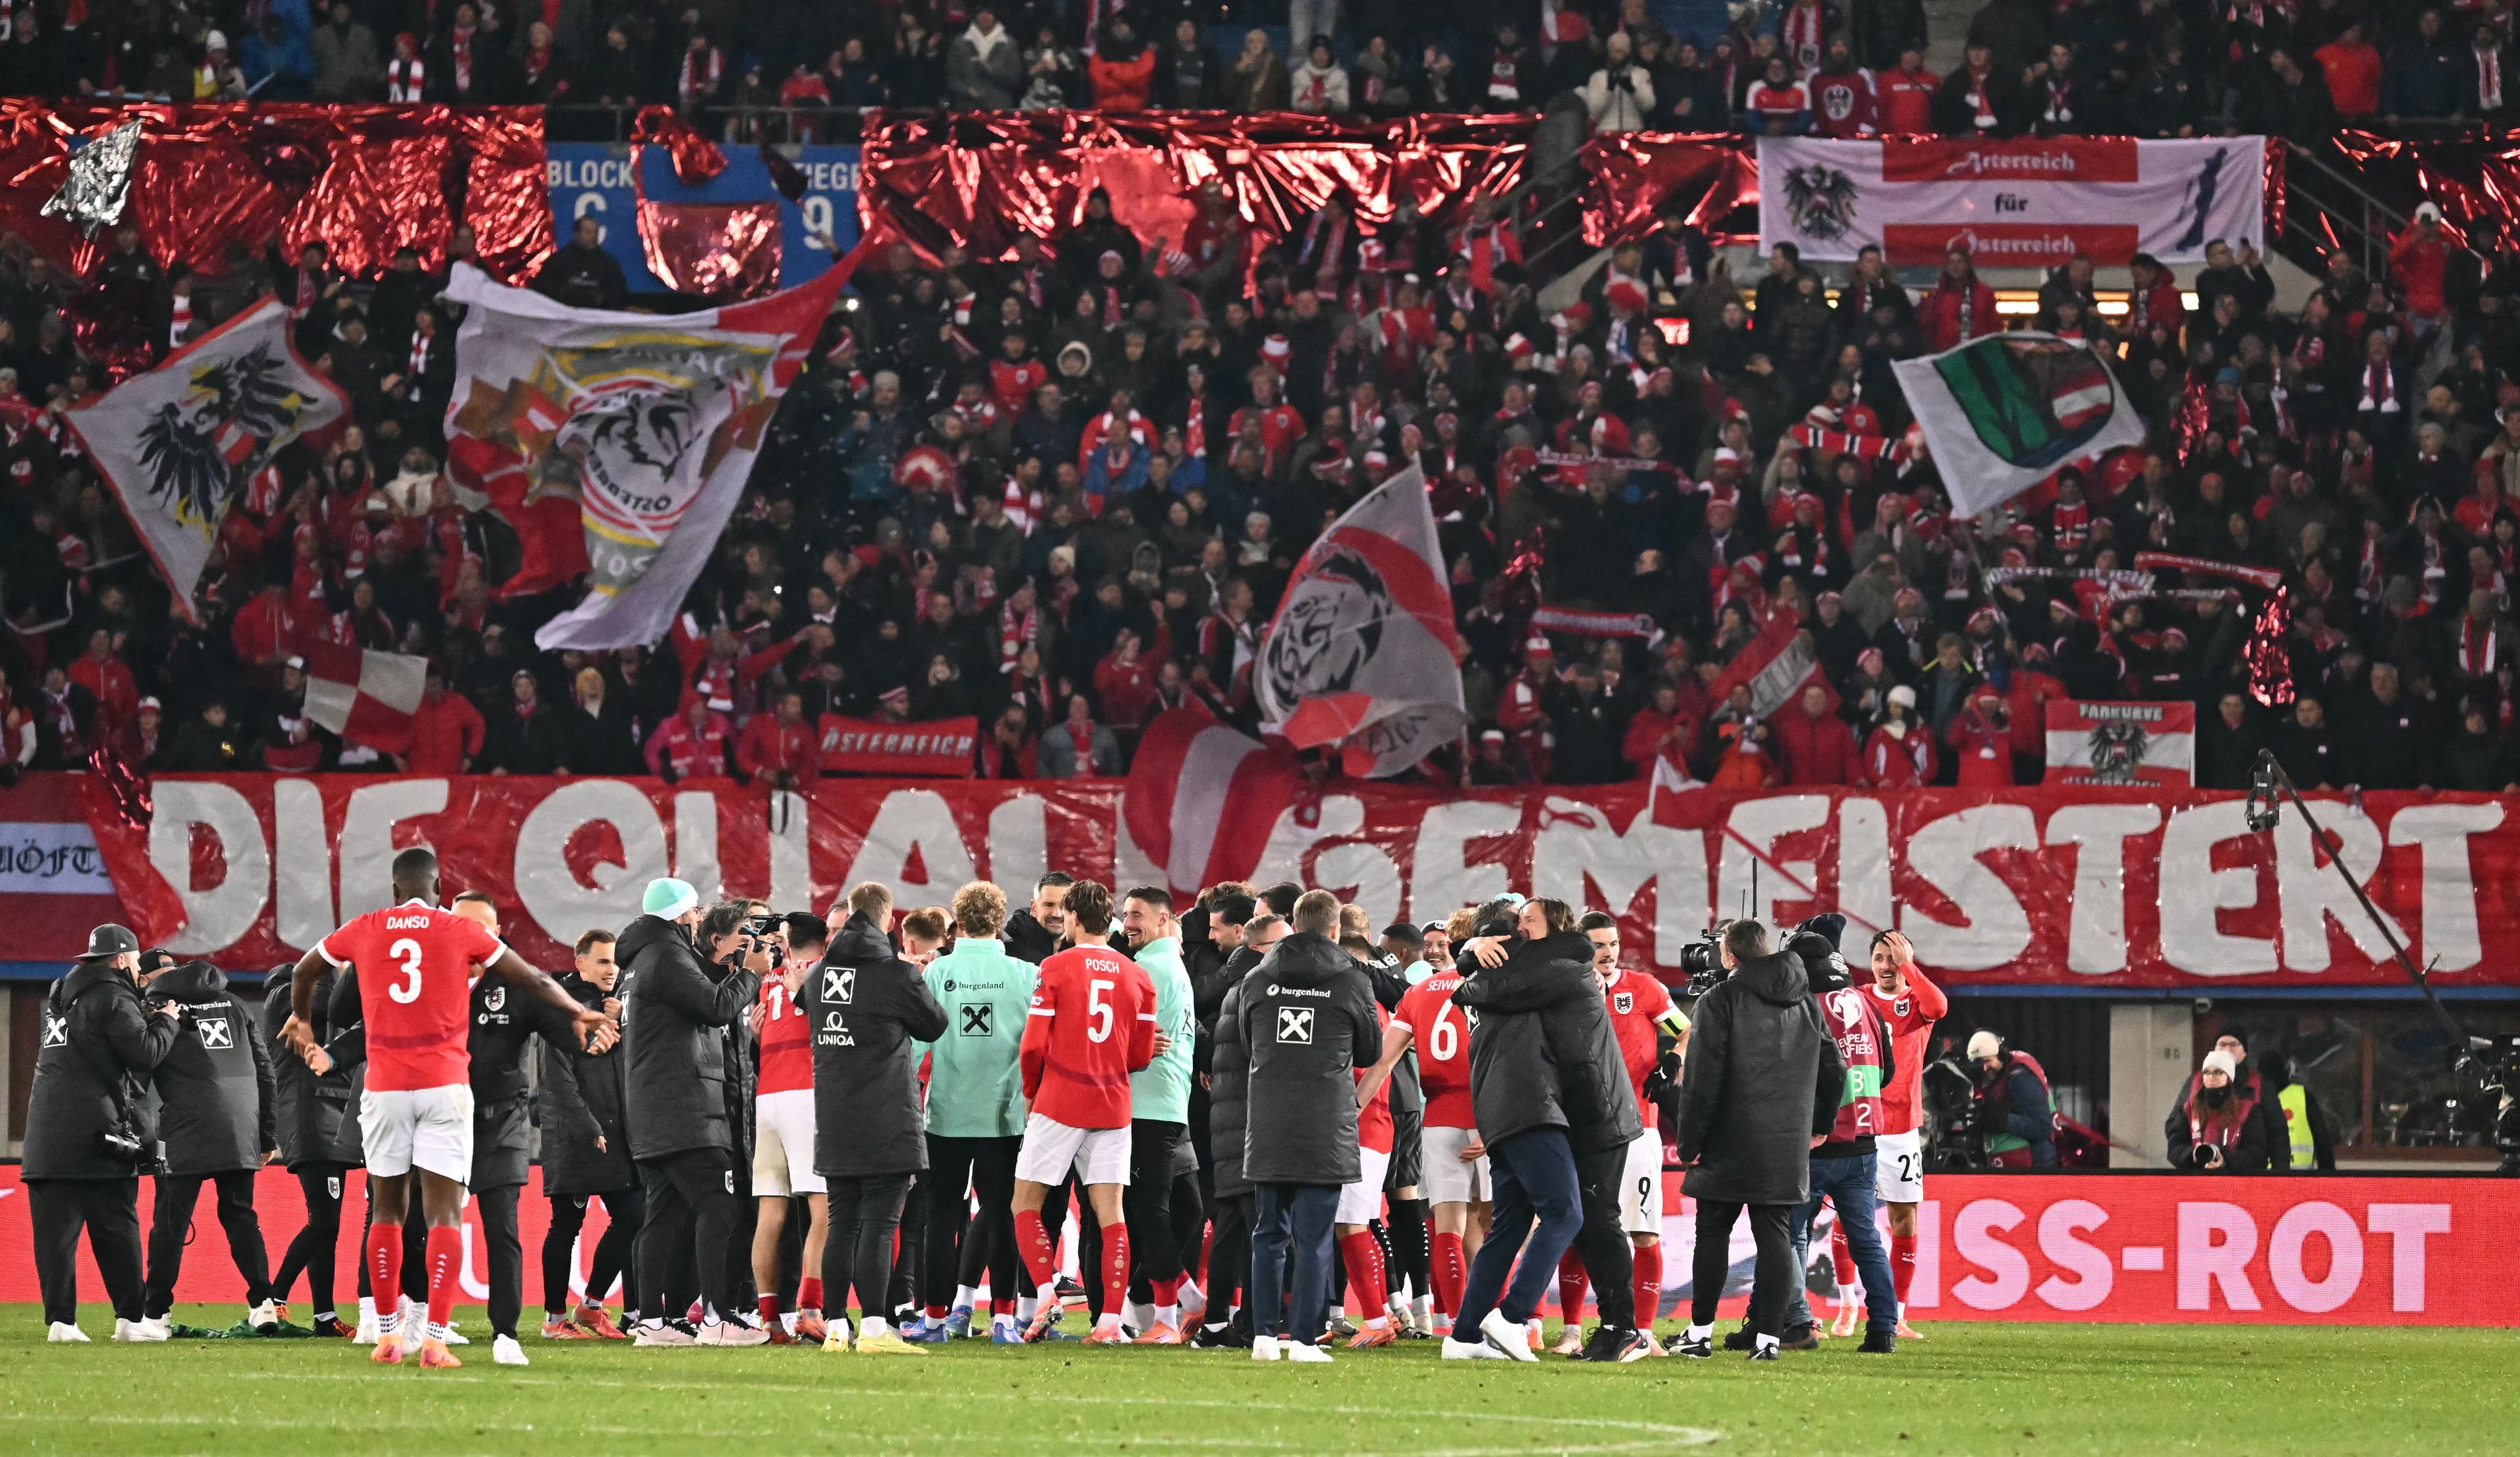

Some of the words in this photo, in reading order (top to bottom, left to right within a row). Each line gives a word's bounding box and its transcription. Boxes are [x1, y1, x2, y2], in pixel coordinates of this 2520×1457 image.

[548, 160, 634, 188] BLOCK
[771, 161, 859, 190] IEGE
[1994, 192, 2028, 215] für
[802, 195, 834, 250] 9
[150, 778, 449, 955] DIE
[1247, 793, 2504, 975] GEMEISTERT
[387, 916, 429, 930] DANSO
[388, 939, 423, 1003] 3
[1085, 958, 1120, 974] POSCH
[959, 981, 1004, 991] burgenland
[1281, 987, 1331, 999] burgenland
[1427, 979, 1462, 992] SEIW
[1087, 979, 1114, 1044] 5
[818, 1034, 855, 1047] UNIQA
[1431, 997, 1458, 1061] 6
[1898, 1152, 1923, 1182] 23
[1638, 1176, 1651, 1207] 9
